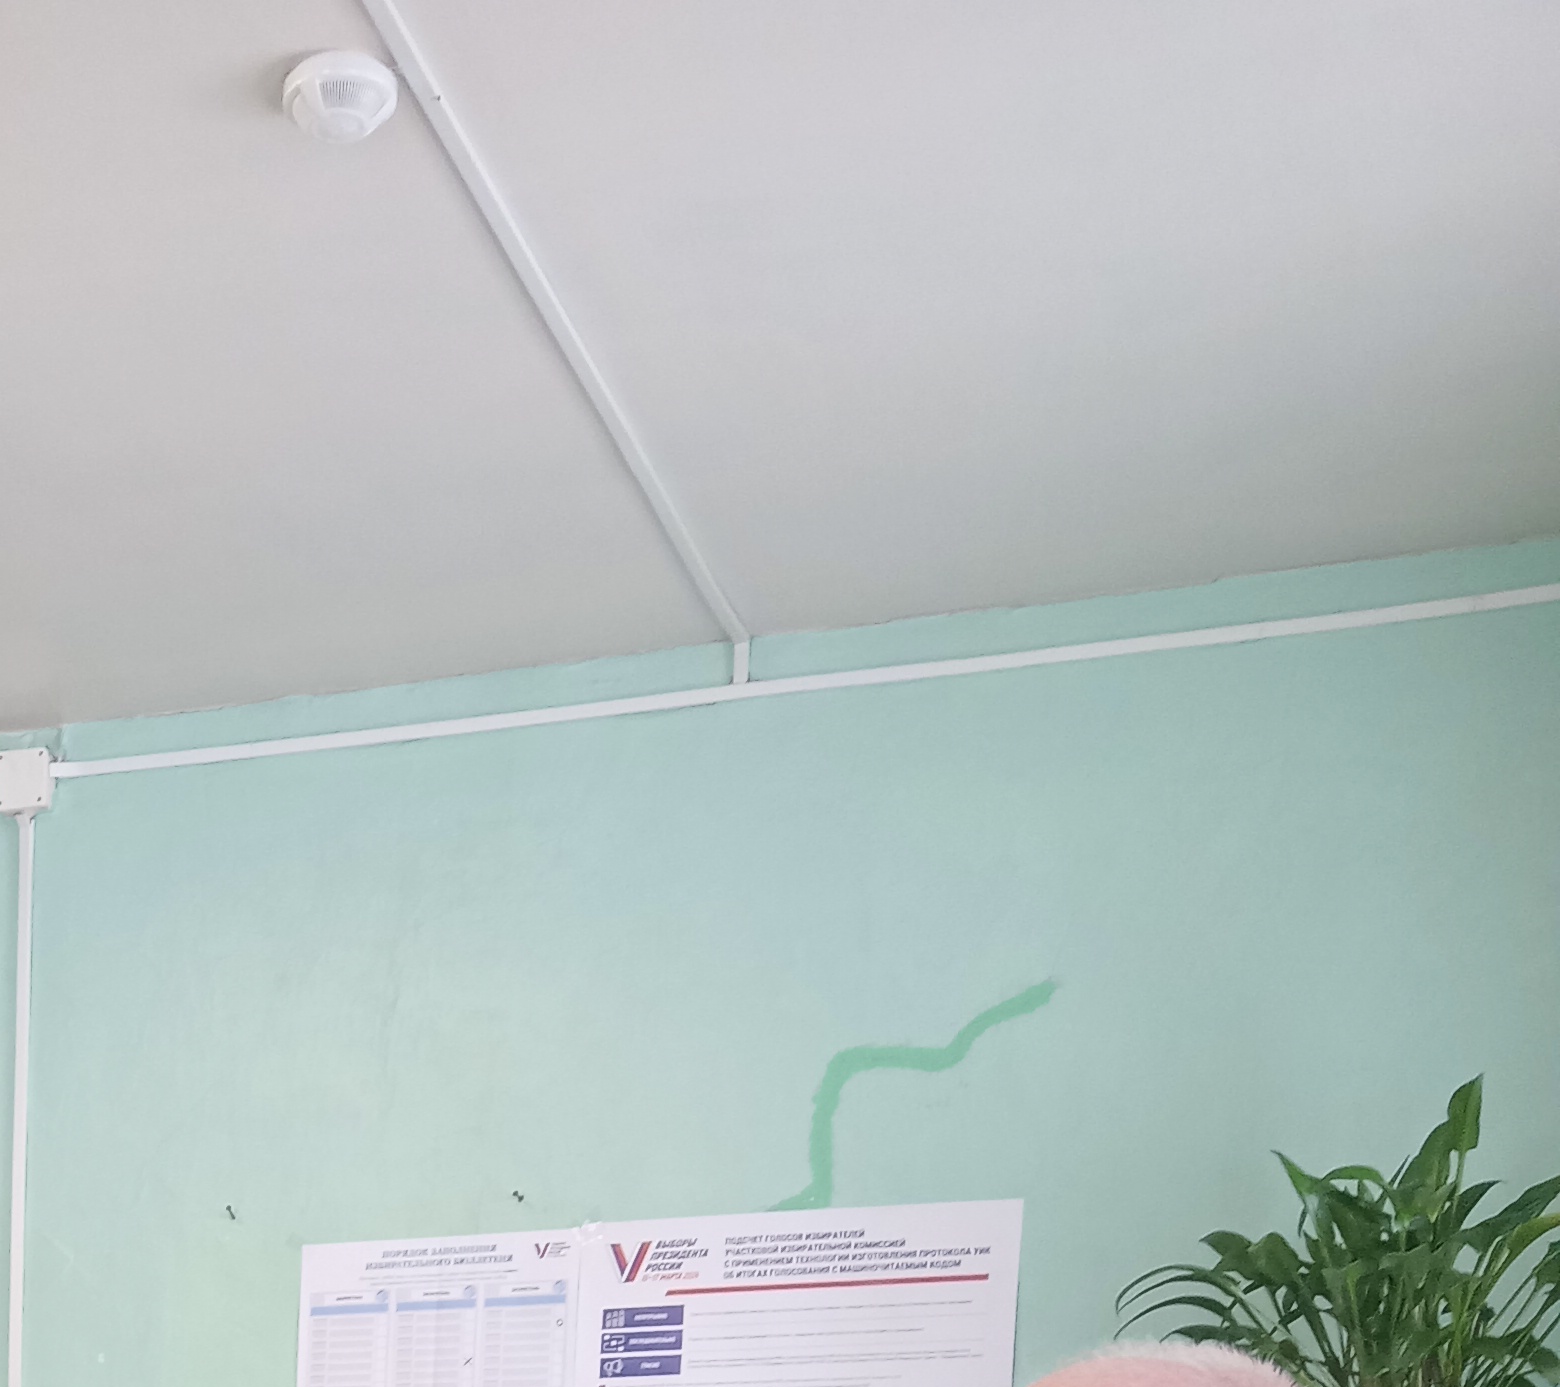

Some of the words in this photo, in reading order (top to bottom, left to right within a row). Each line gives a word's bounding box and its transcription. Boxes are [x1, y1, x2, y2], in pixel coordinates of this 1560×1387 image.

[764, 1233, 803, 1243] ГОЛОСОВ
[805, 1229, 865, 1240] ИЗБИРАТЕЛЕЙ
[655, 1238, 698, 1249] ВЫБОРЫ
[725, 1245, 779, 1256] УЧАСТКОВОЙ
[780, 1241, 851, 1253] ИЗБИРАТЕЛЬНОЙ
[854, 1237, 906, 1249] КОМИССИЕЙ
[650, 1249, 709, 1260] ПРЕЗИДЕНТА
[731, 1257, 794, 1267] ПРИМЕНЕНИЕМ
[795, 1253, 849, 1263] ТЕХНОЛОГИИ
[852, 1249, 918, 1261] ИЗГОТОВЛЕНИЯ
[919, 1248, 971, 1258] ПРОТОКОЛА
[973, 1246, 991, 1255] УИК
[645, 1262, 683, 1272] РОССИИ
[736, 1269, 768, 1278] ИТОГАХ
[770, 1266, 830, 1276] ГОЛОСОВАНИЯ
[840, 1260, 928, 1273] МАШИНОЧИТАЕМЫМ
[929, 1259, 962, 1270] КОДОМ
